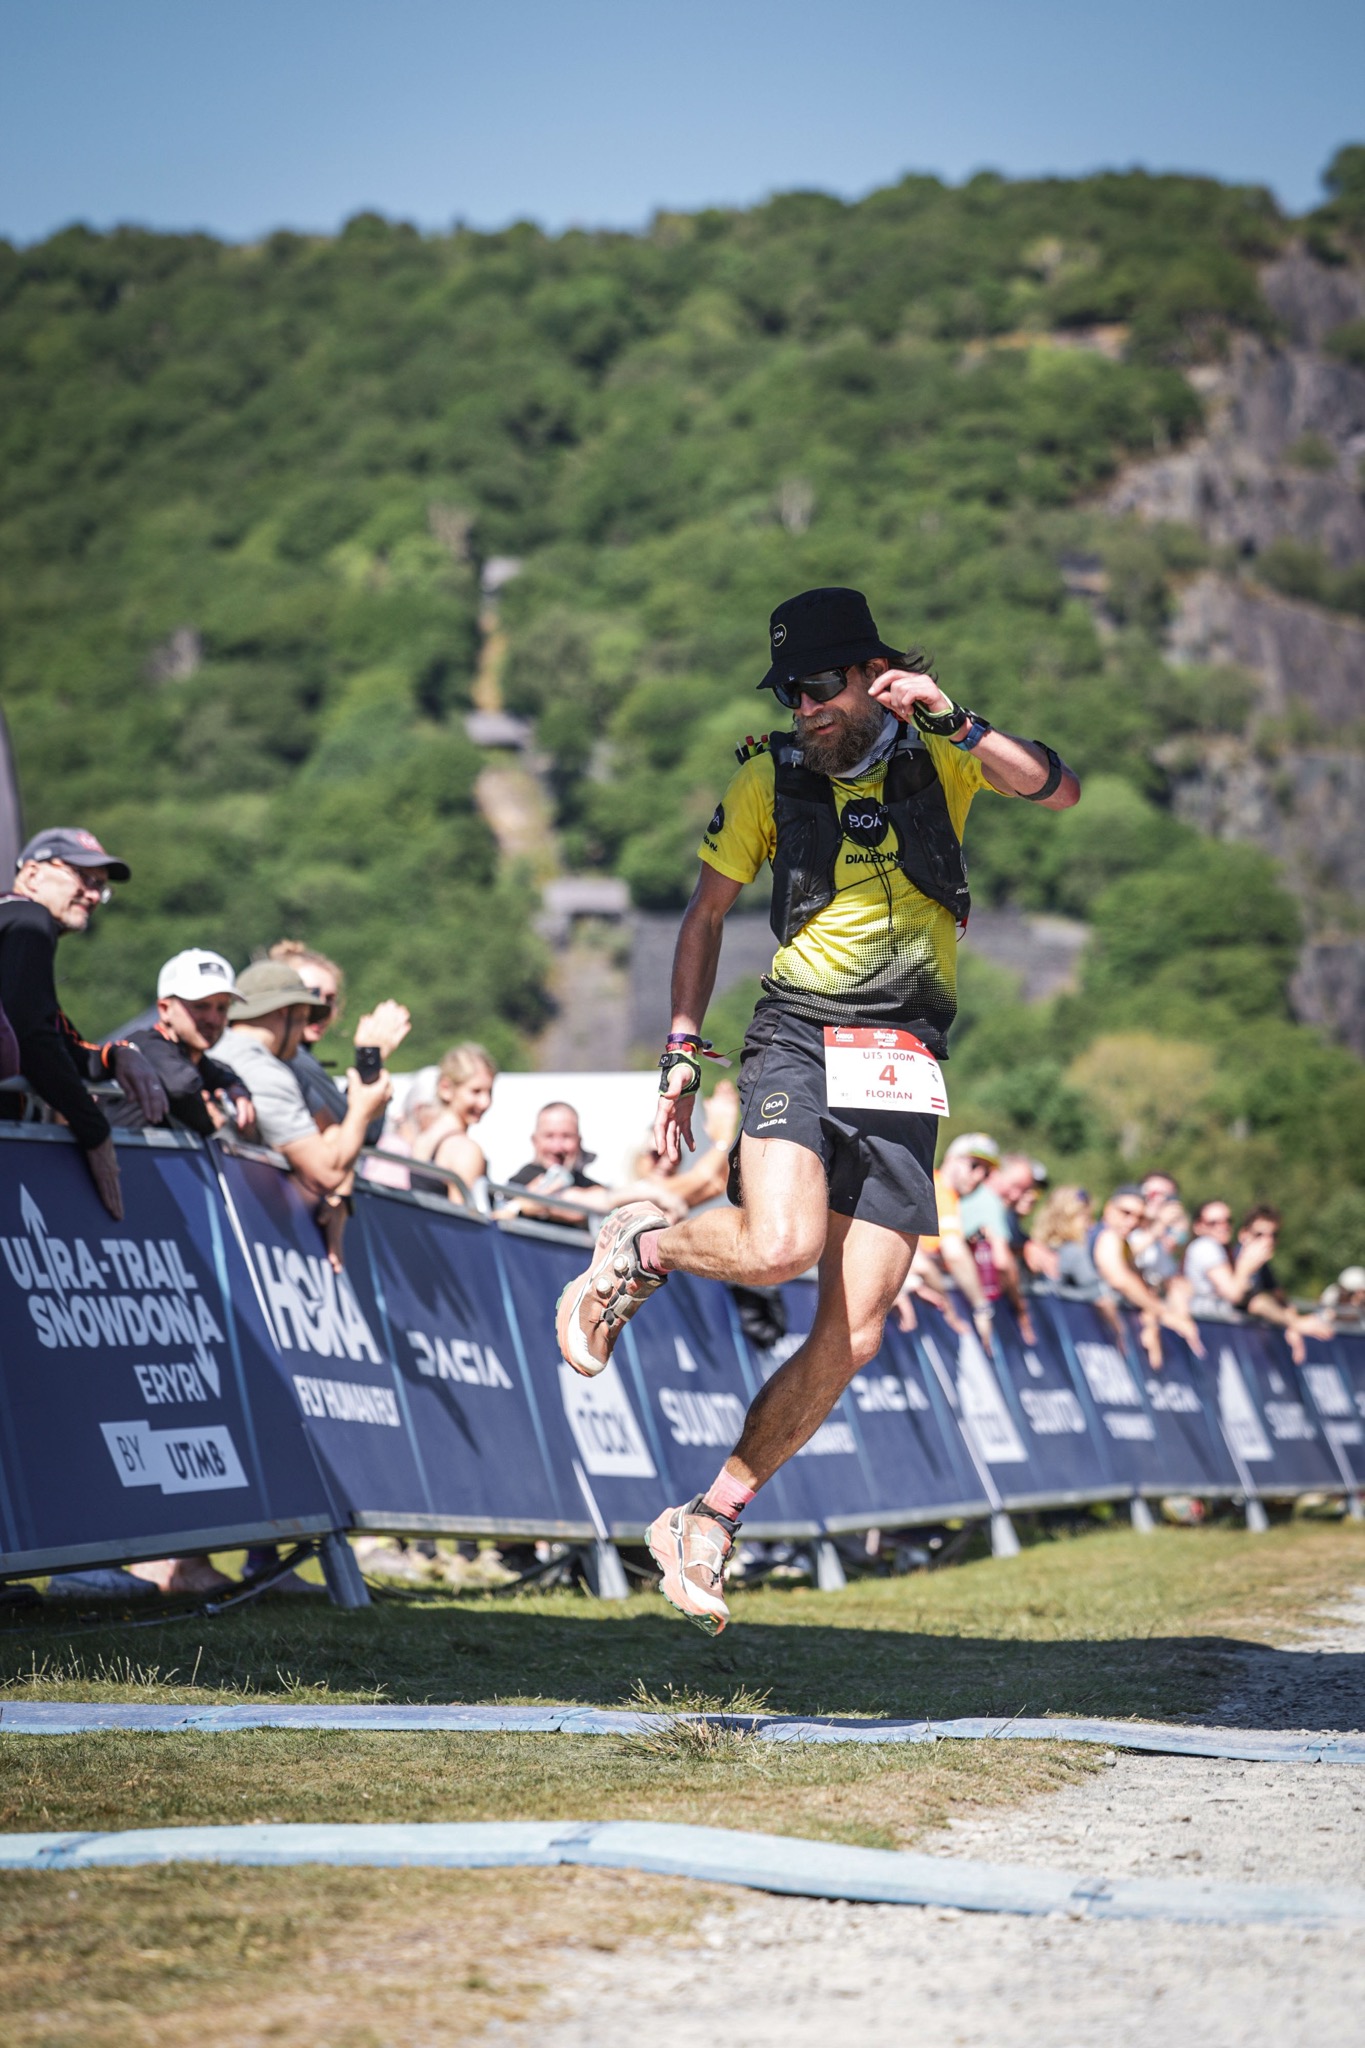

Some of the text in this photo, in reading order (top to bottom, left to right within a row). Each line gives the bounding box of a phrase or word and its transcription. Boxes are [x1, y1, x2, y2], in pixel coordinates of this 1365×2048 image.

[848, 813, 883, 829] BOA
[845, 853, 886, 864] DIALED
[863, 1051, 915, 1062] UTS 100M
[879, 1065, 898, 1086] 4
[765, 1100, 784, 1110] BOA
[865, 1089, 913, 1100] FLORIAN
[253, 1241, 384, 1365] HOKA
[28, 1294, 226, 1349] SNOWDONIA
[406, 1330, 514, 1389] DACIA
[133, 1362, 208, 1405] ERYRI
[116, 1434, 228, 1480] BY UTMB
